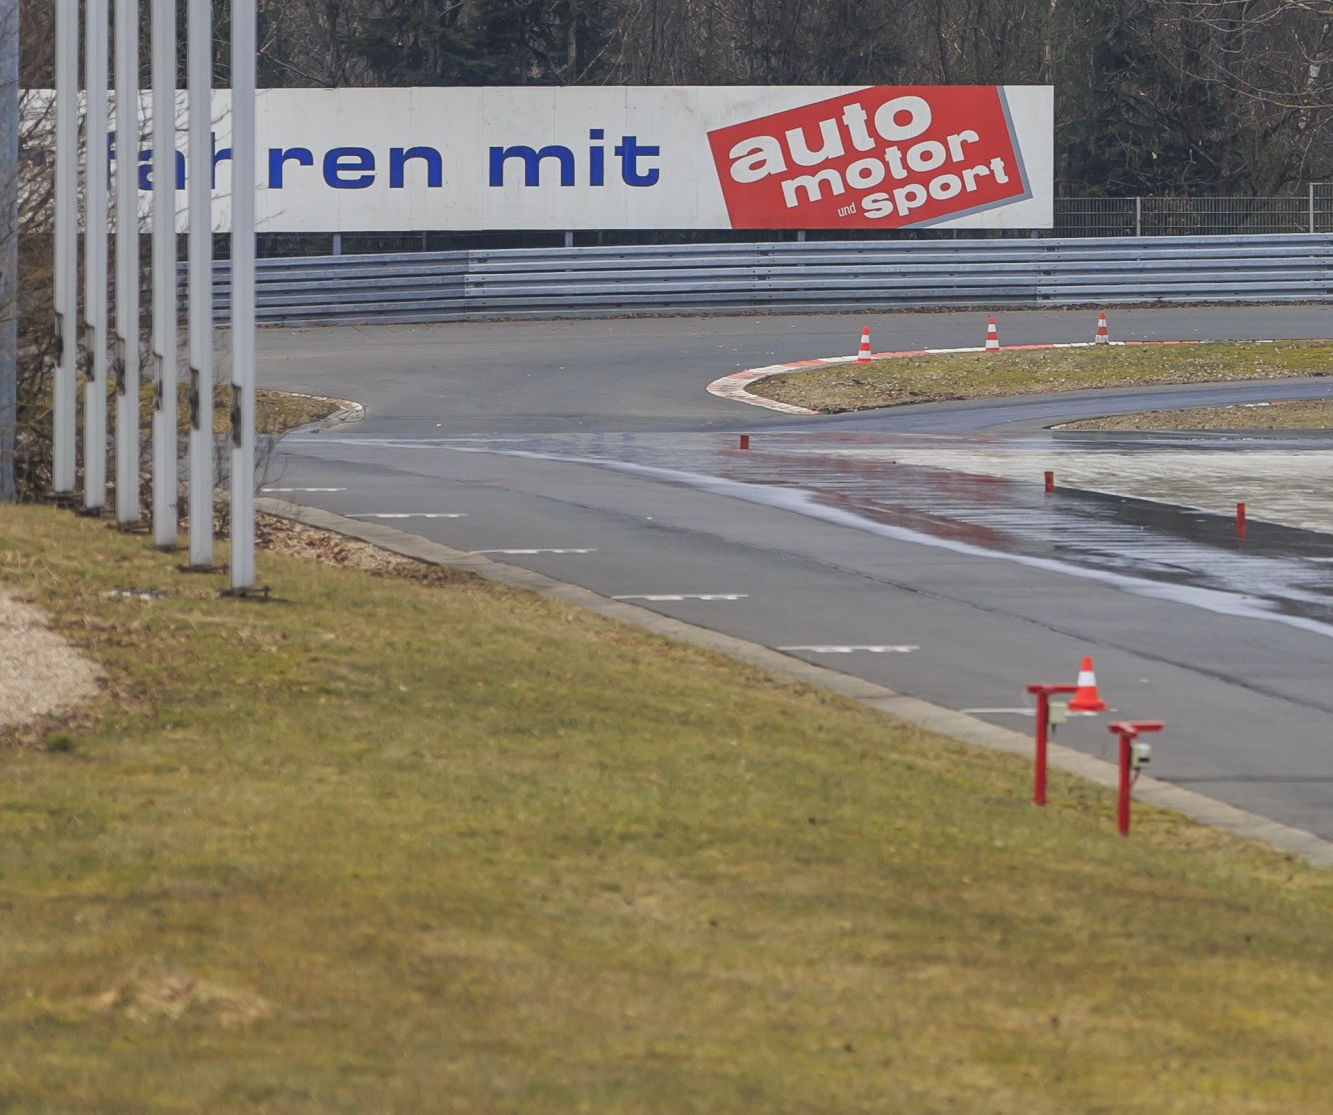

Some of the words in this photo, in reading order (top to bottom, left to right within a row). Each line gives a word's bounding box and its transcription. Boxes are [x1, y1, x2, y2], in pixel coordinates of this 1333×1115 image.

[489, 128, 660, 187] mit
[728, 95, 932, 184] auto
[780, 129, 980, 209] motor
[837, 201, 857, 218] und
[860, 156, 1010, 220] sport
